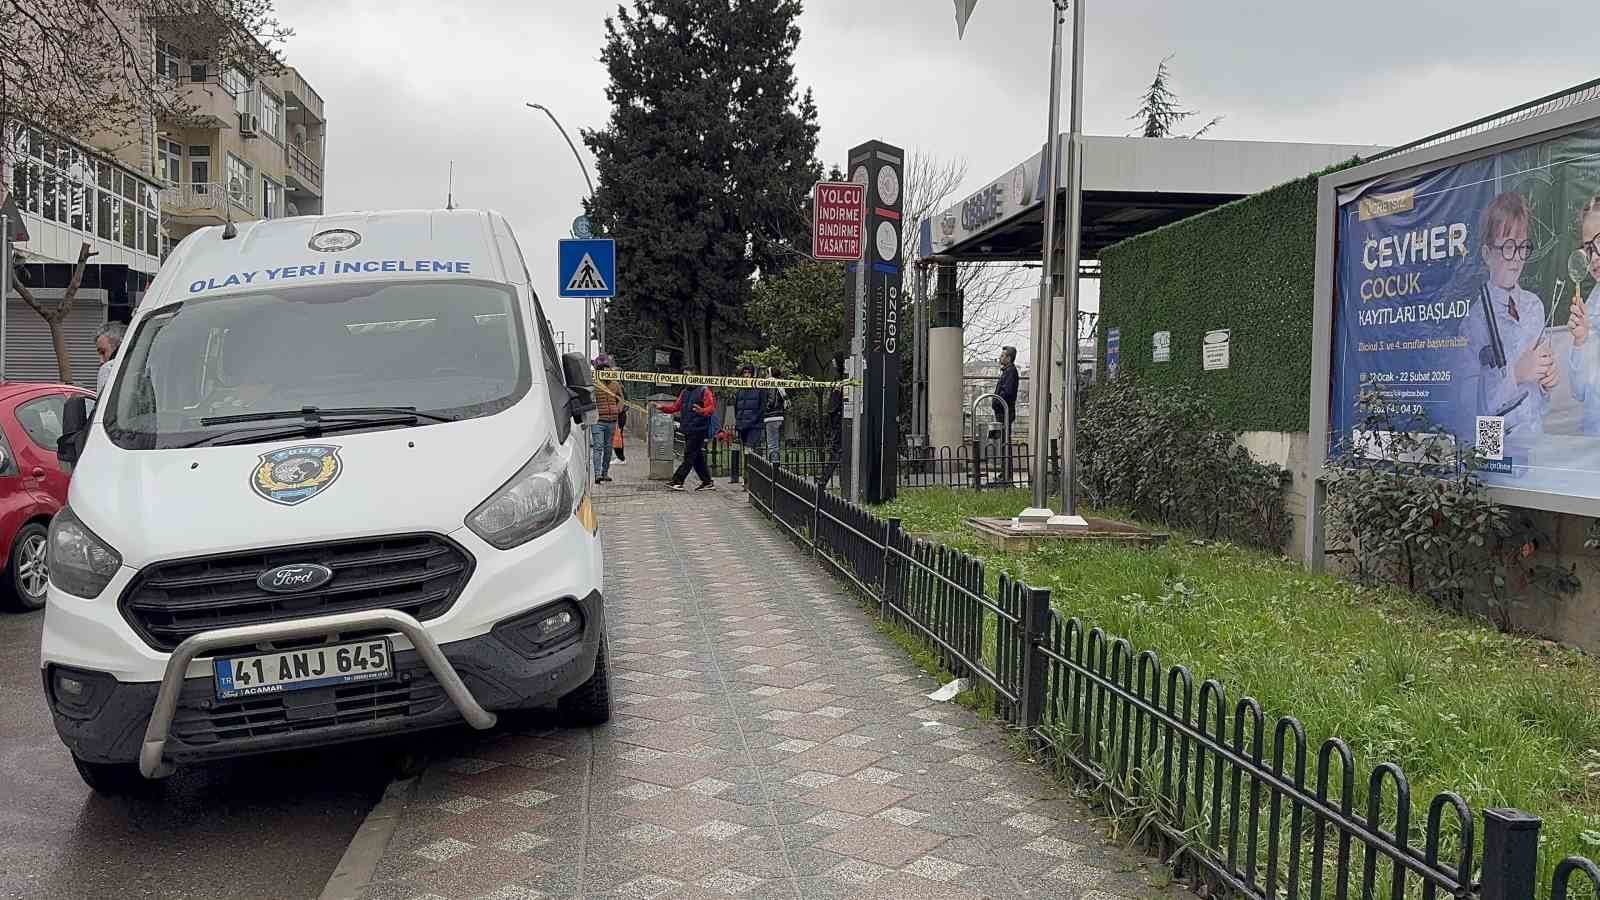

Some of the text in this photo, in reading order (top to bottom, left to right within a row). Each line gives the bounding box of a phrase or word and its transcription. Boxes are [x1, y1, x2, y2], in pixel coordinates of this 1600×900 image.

[821, 189, 860, 204] YOLCU
[819, 206, 859, 221] İNDİRME
[819, 239, 858, 254] YASAKTIR!
[1363, 223, 1468, 270] CEVHER
[189, 260, 471, 293] OLAY YERİ İNCELEME
[1360, 272, 1421, 303] ÇOCUK
[885, 286, 897, 354] Gebze
[1359, 299, 1471, 326] KAYITLARI BAŞLADI
[1431, 370, 1451, 382] 2026
[273, 568, 312, 586] Ford
[235, 643, 385, 685] 41 ANJ 645
[221, 676, 232, 685] TR
[244, 684, 283, 696] ACAMAR
